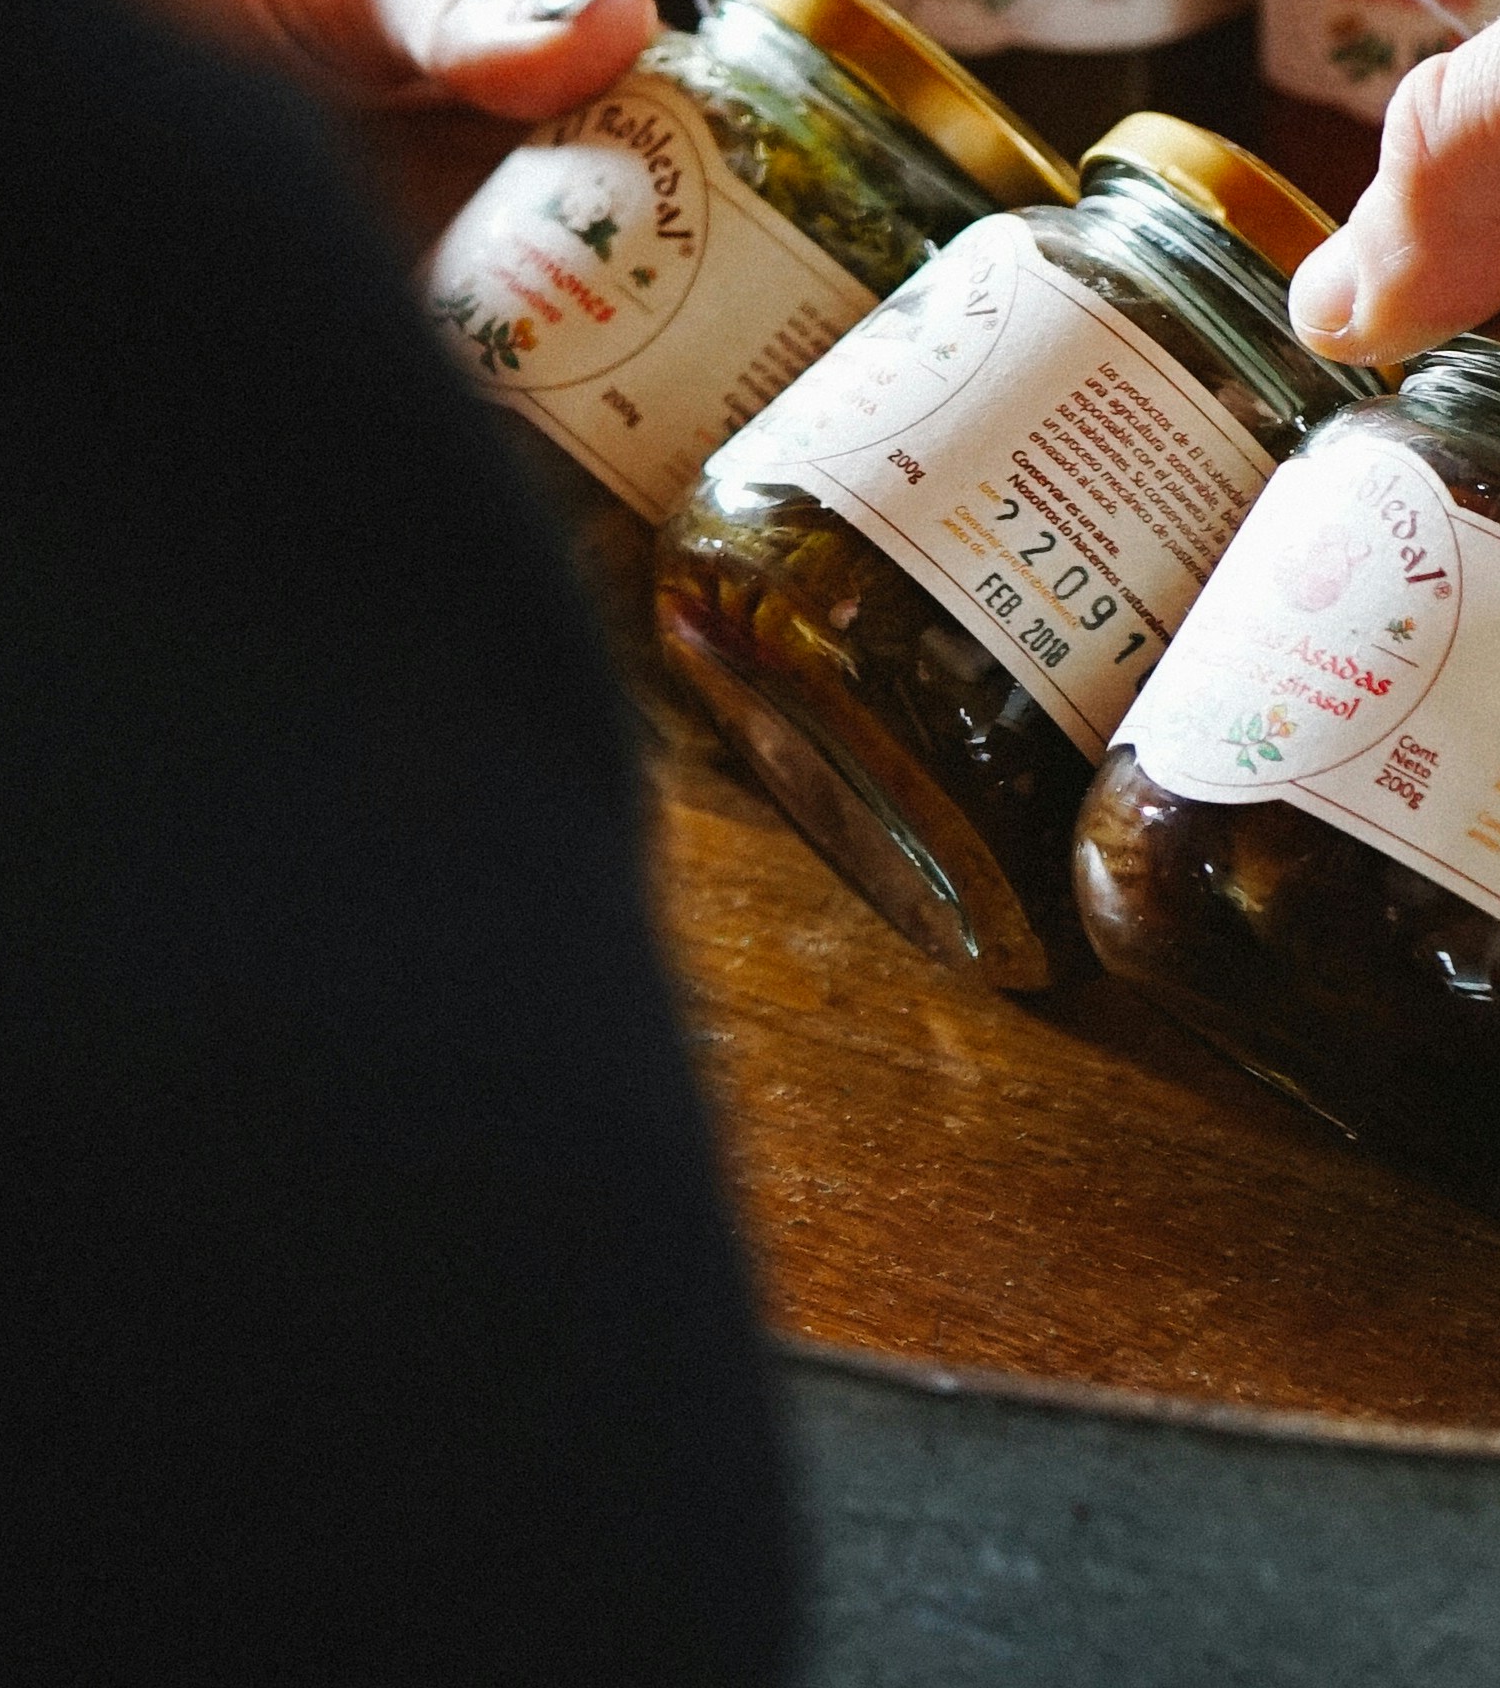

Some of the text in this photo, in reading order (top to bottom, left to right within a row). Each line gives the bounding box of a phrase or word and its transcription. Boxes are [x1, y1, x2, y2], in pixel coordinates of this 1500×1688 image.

[1055, 403, 1077, 424] sus
[1129, 470, 1147, 488] Su
[1084, 377, 1109, 399] una
[1108, 398, 1167, 453] agricultura
[1097, 361, 1120, 382] Los
[1114, 379, 1175, 433] productos
[1172, 431, 1190, 448] de
[1188, 446, 1205, 461] El
[887, 448, 926, 486] 200g
[1028, 431, 1078, 478] envasado
[1077, 474, 1092, 489] al
[1042, 417, 1060, 434] un
[1056, 430, 1102, 473] proceso
[1100, 470, 1153, 524] mecánico
[1152, 522, 1170, 539] de
[1069, 390, 1135, 449] responsable
[1132, 447, 1157, 470] con
[1154, 468, 1169, 482] el
[1162, 480, 1203, 524] planeta
[1006, 473, 1062, 526] Nosotros
[1057, 519, 1071, 537] lo
[1068, 531, 1122, 586] hacemos
[1011, 449, 1122, 559] Conservar es un arte.
[974, 572, 1070, 668] FEB. 2018
[995, 498, 1156, 690] 22091
[1291, 635, 1394, 696] Asadas
[1374, 768, 1425, 810] 200g
[1390, 748, 1432, 779] Neto
